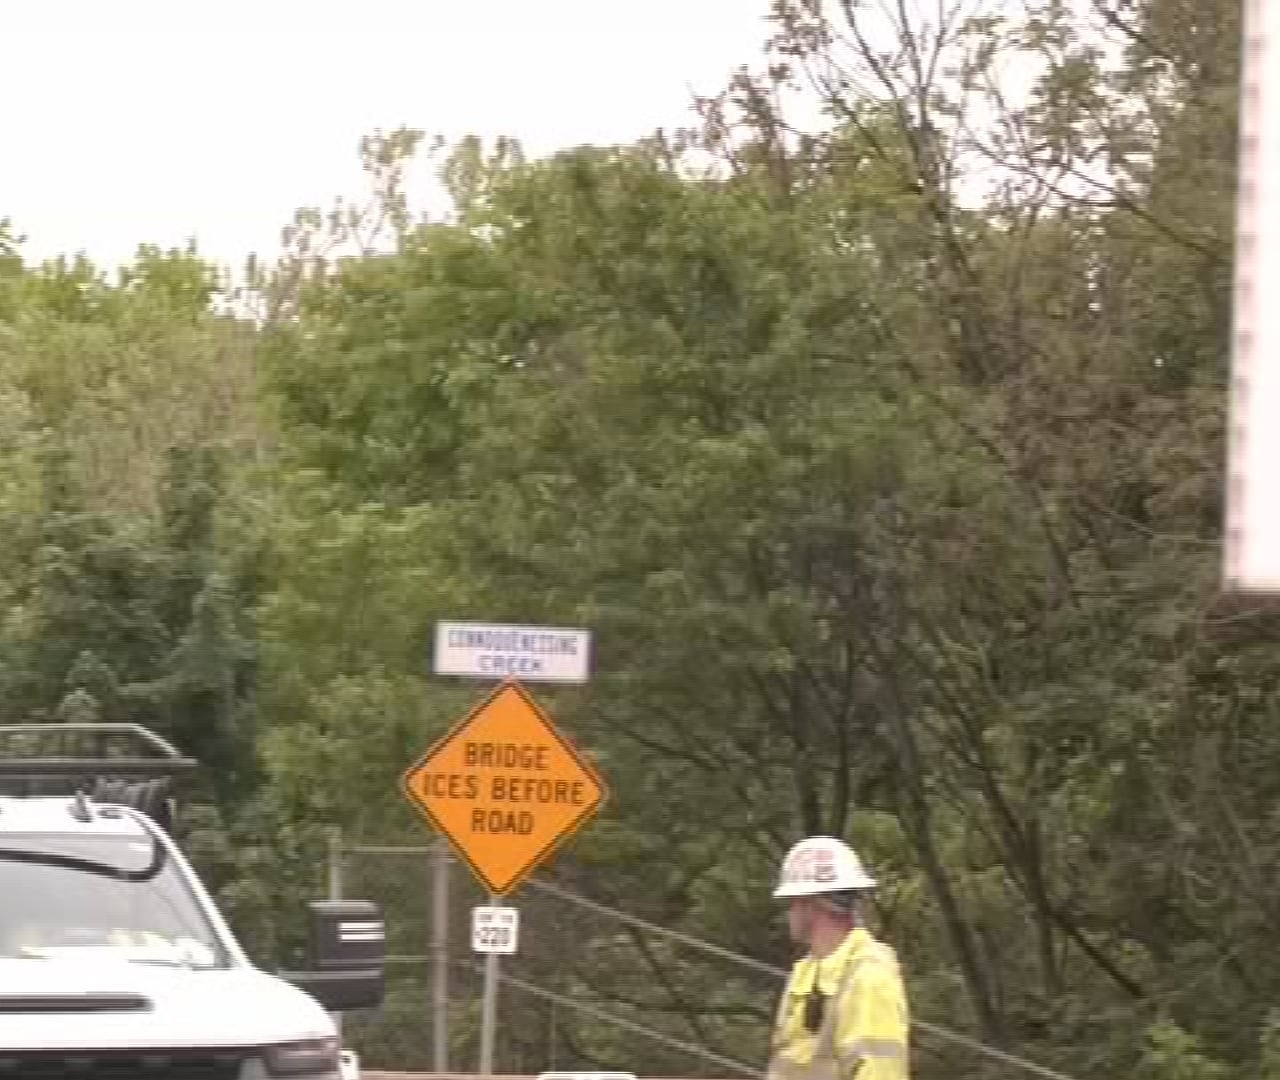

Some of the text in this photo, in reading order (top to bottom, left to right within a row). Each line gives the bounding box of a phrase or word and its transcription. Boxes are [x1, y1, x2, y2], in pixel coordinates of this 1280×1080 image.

[478, 655, 541, 673] CREEK
[464, 742, 550, 770] BRIDGE
[423, 773, 584, 806] ICES BEFORE
[471, 809, 535, 836] ROAD
